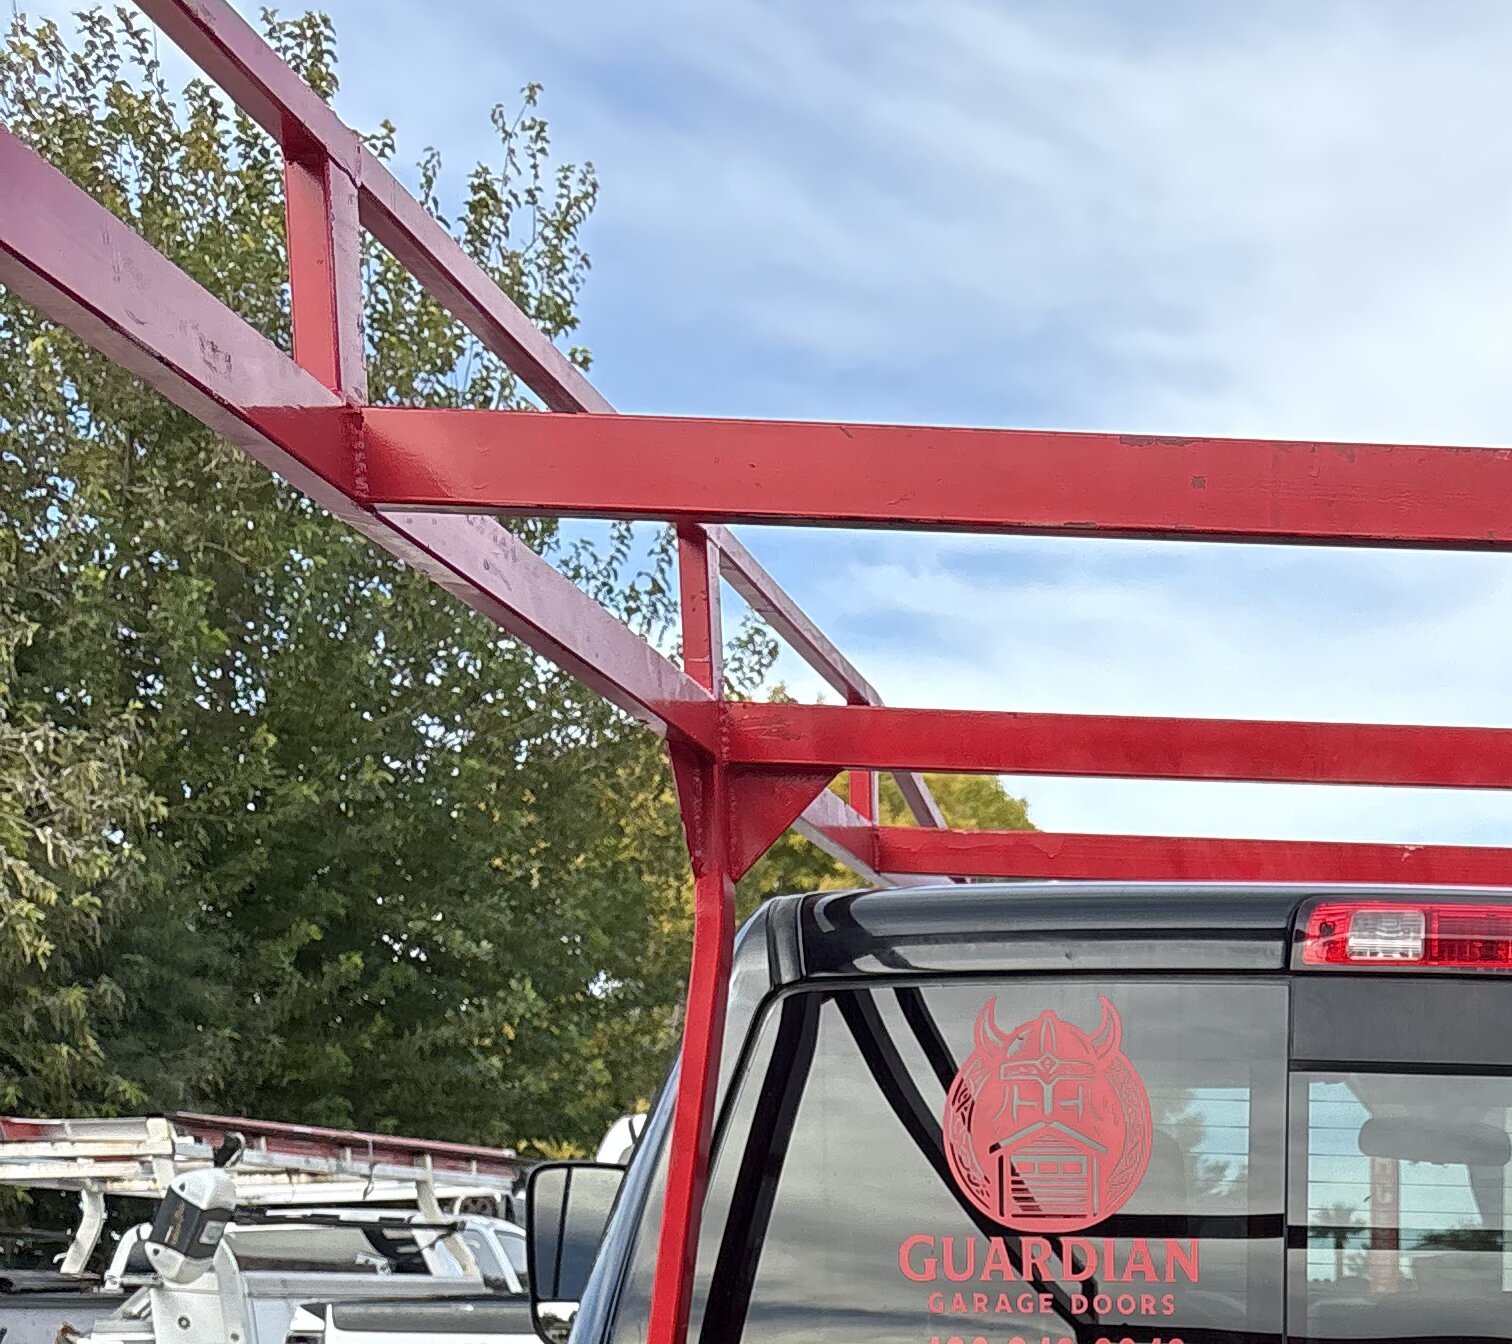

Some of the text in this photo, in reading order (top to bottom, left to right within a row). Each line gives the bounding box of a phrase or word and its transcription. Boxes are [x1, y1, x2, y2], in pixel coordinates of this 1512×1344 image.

[900, 1235, 1199, 1283] GUARDIAN
[928, 1293, 1175, 1315] GARAGE DOORS
